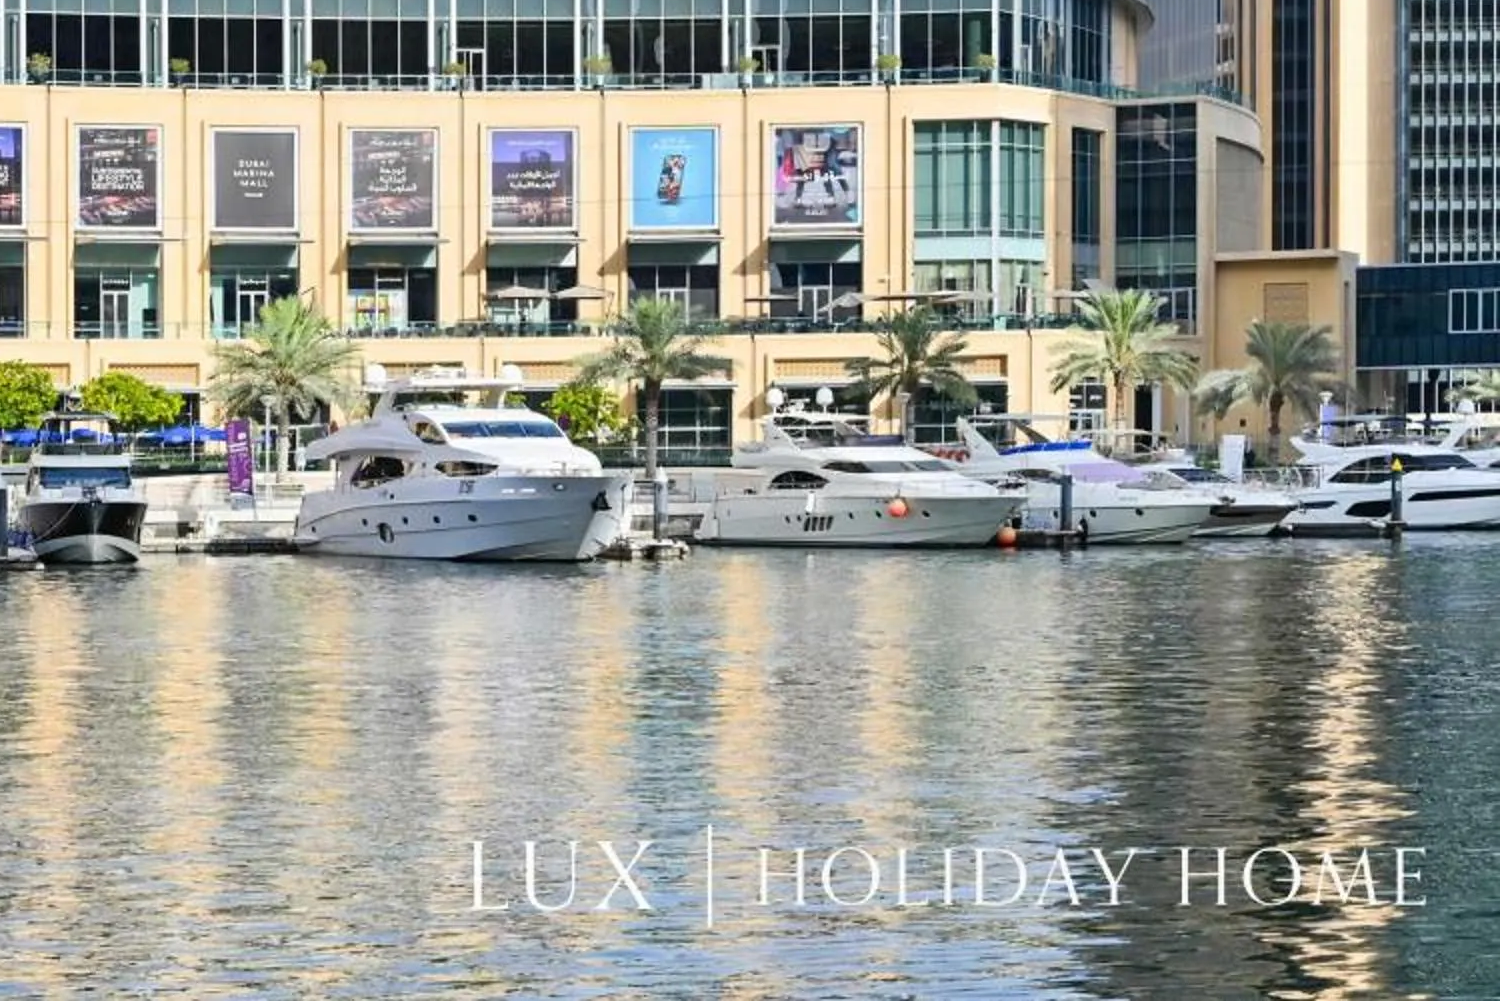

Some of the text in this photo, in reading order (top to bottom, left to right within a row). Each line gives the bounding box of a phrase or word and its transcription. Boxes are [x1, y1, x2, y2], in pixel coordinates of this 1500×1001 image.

[239, 159, 270, 168] DUBAI
[233, 169, 274, 178] MARINA
[239, 179, 268, 188] MALL
